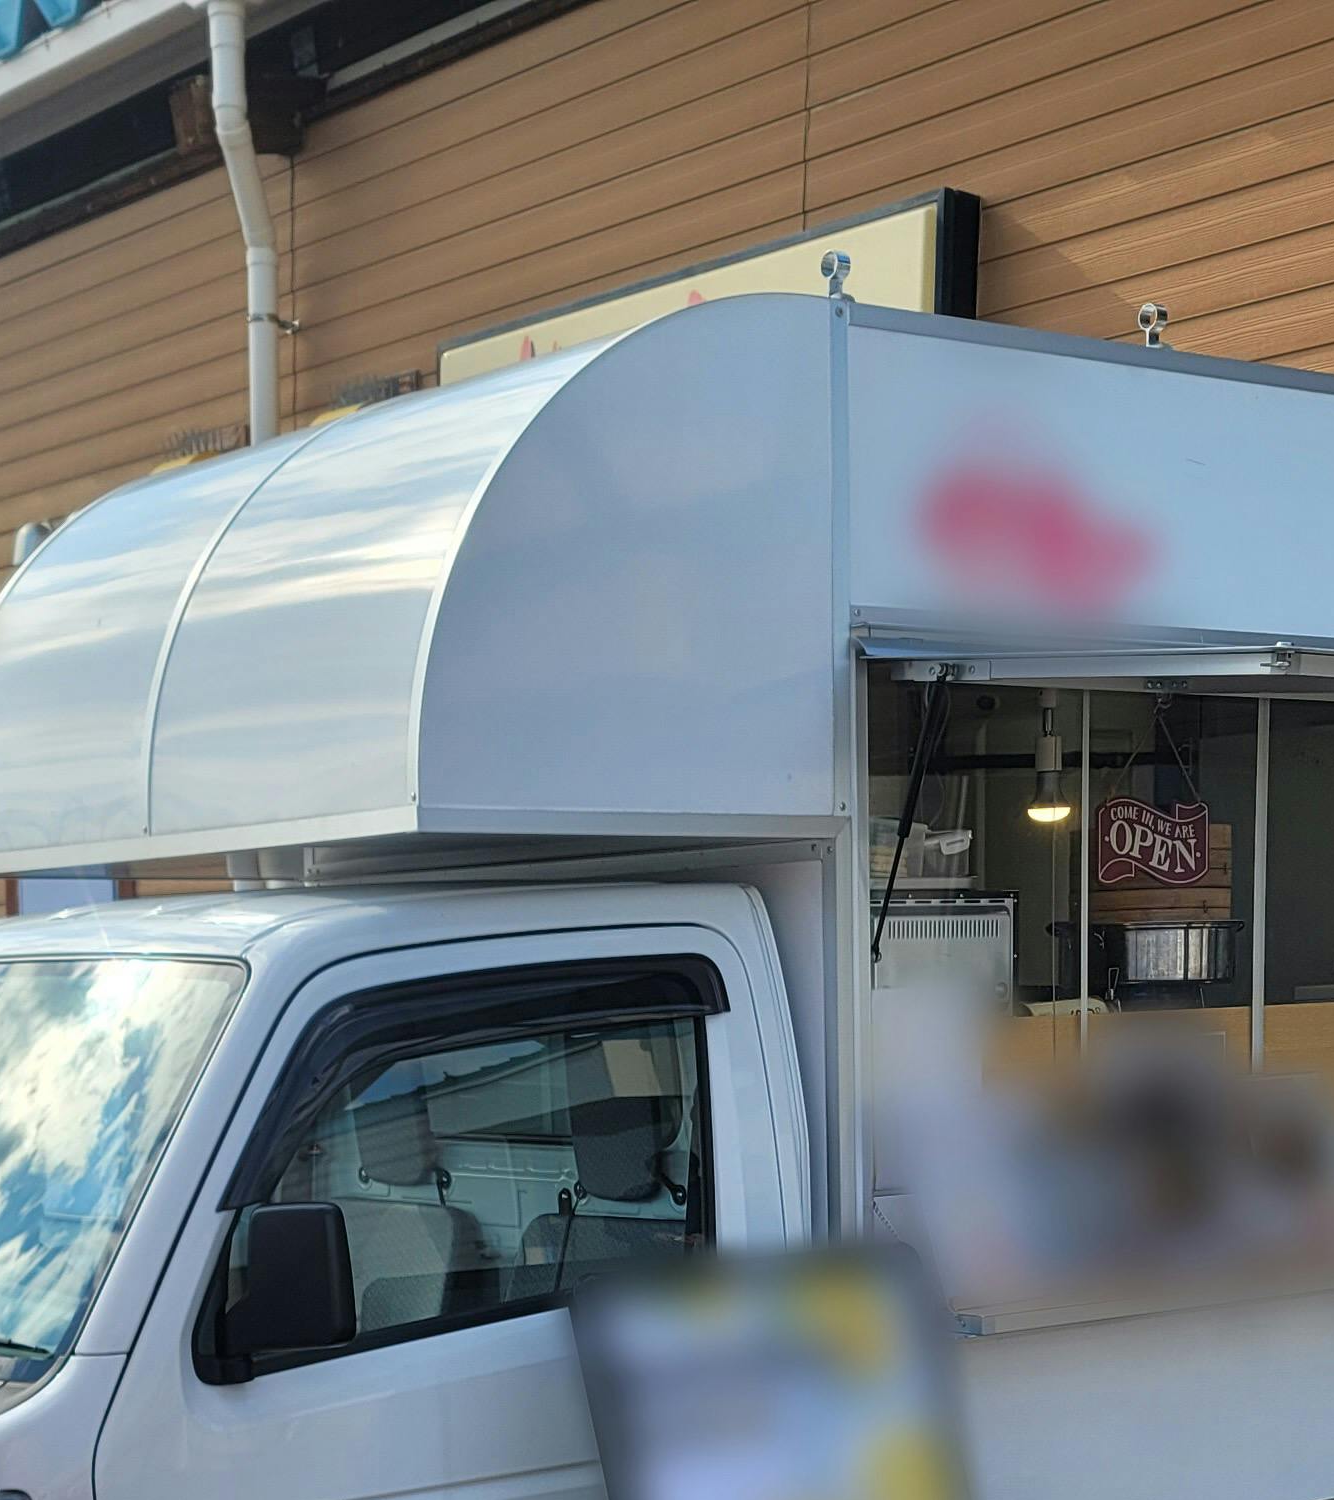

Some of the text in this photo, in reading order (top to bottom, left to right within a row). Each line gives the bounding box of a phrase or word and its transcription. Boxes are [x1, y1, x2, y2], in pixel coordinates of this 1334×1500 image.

[1110, 806, 1196, 839] COME IN, WE ARE
[1109, 820, 1197, 873] OPEN
